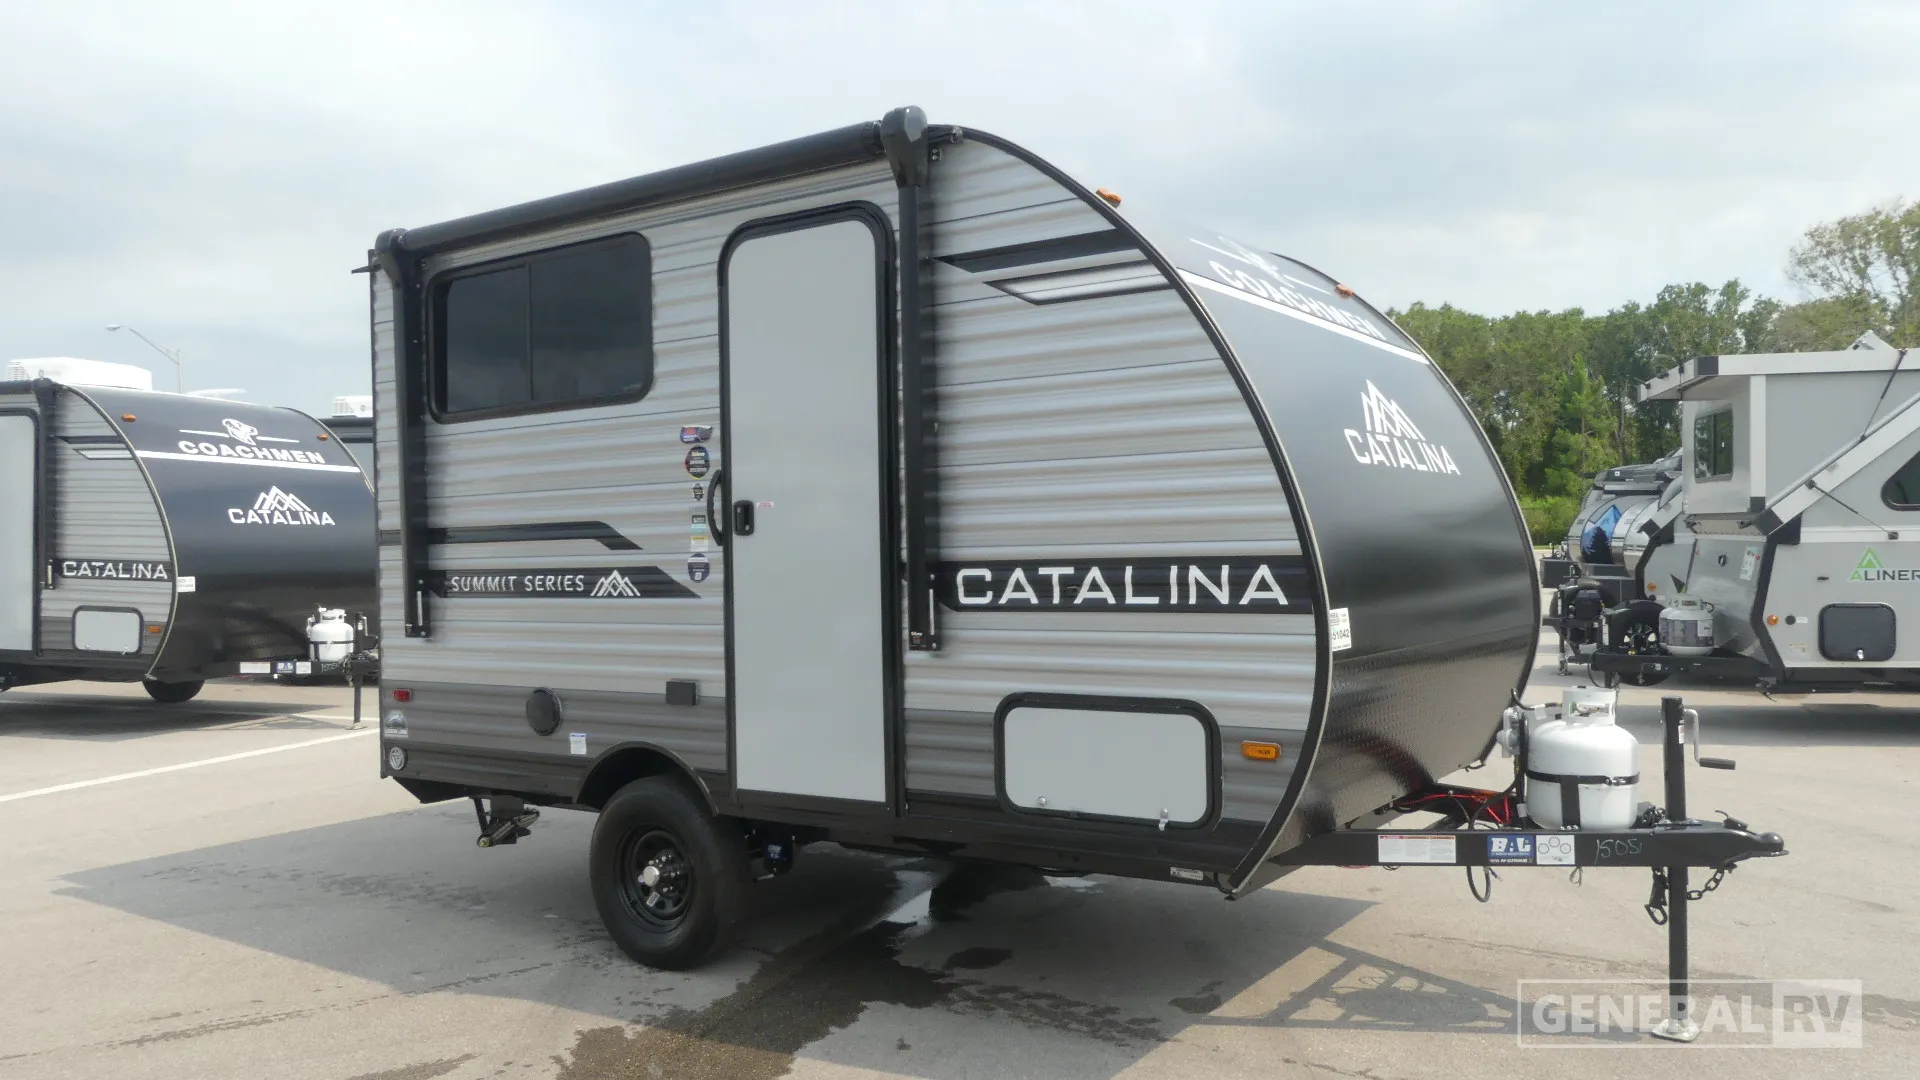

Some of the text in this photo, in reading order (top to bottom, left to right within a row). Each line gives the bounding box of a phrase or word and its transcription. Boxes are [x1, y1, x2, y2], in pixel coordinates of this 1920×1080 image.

[1208, 259, 1387, 341] COACHMEN
[178, 440, 326, 464] COACHMEN
[1343, 428, 1461, 476] CATALINA
[228, 508, 336, 526] CATALINA
[62, 561, 168, 580] CATALINA
[451, 574, 585, 592] SUMMIT SERIES
[956, 564, 1288, 605] CATALINA
